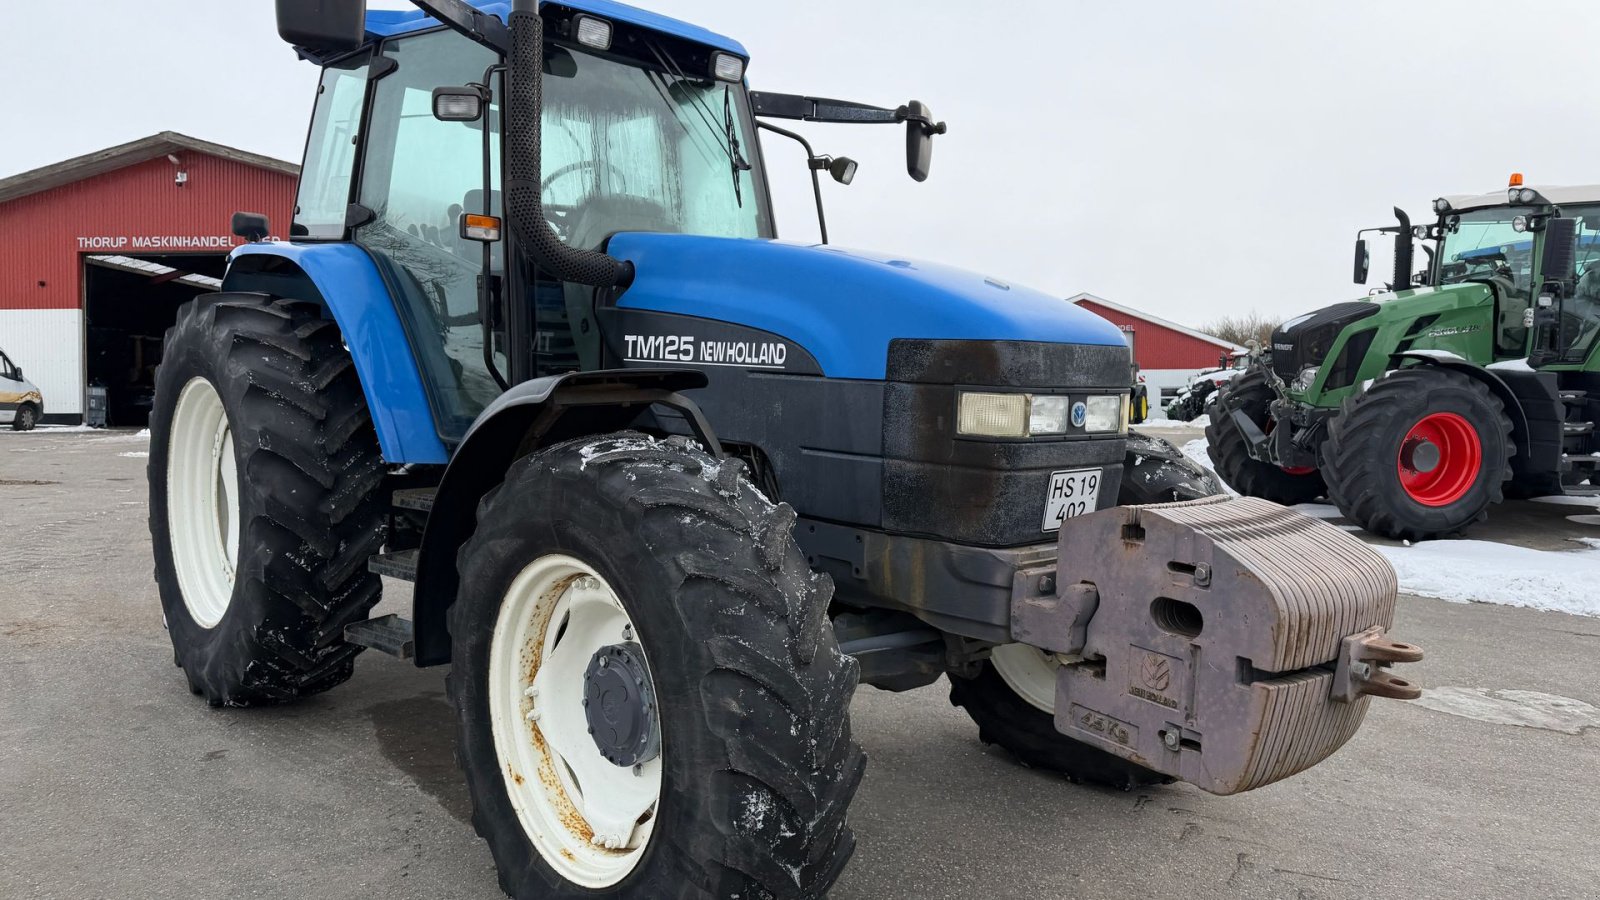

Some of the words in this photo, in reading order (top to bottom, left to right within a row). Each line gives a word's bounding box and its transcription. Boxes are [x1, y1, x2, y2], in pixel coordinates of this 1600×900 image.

[77, 236, 127, 248] THORUP
[132, 236, 235, 248] MASKINHANDEL
[624, 335, 695, 361] TM125
[700, 341, 726, 362] NEW
[726, 341, 787, 365] HOLLAND
[1052, 477, 1075, 499] HS
[1080, 475, 1097, 496] 19
[1056, 501, 1086, 522] 402
